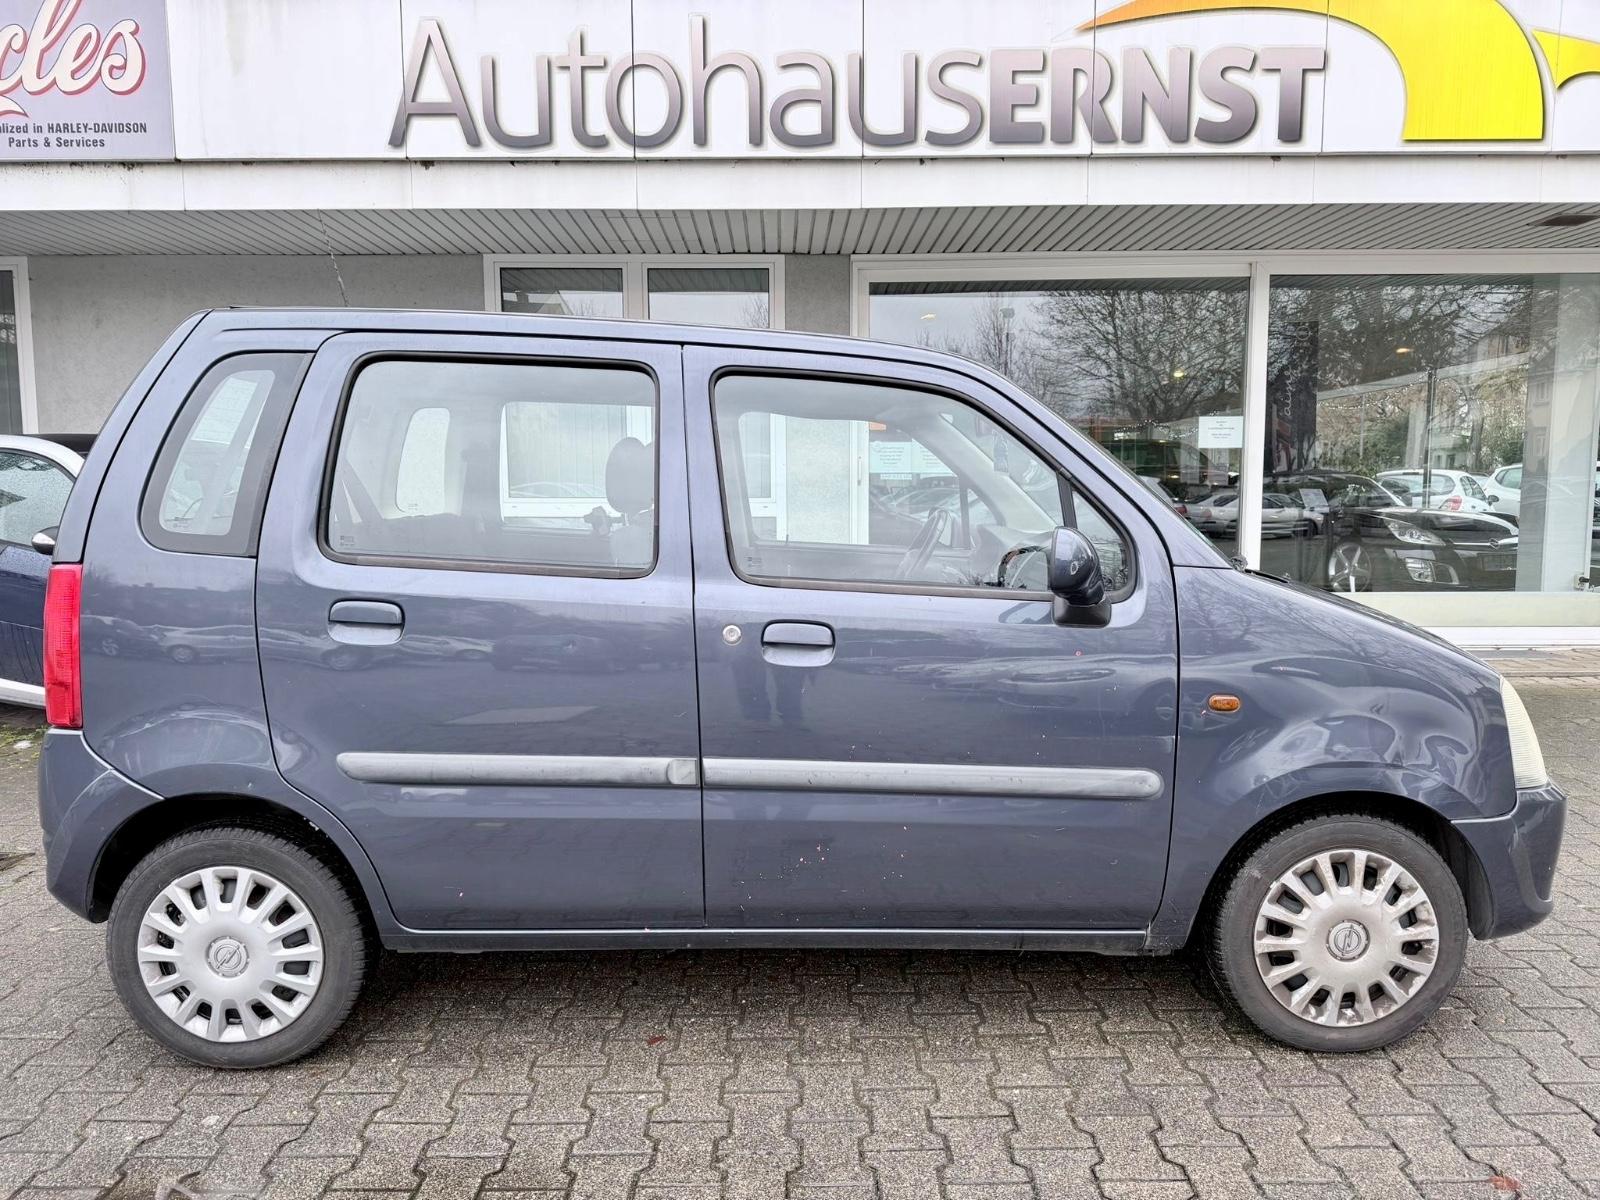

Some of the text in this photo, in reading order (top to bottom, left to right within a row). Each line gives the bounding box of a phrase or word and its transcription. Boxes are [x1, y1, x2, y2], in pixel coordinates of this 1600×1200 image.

[388, 14, 1326, 148] AutohausERNST
[33, 123, 43, 134] in
[47, 122, 147, 134] HARLEY-DAVIDSON
[8, 137, 105, 148] Parts & Services
